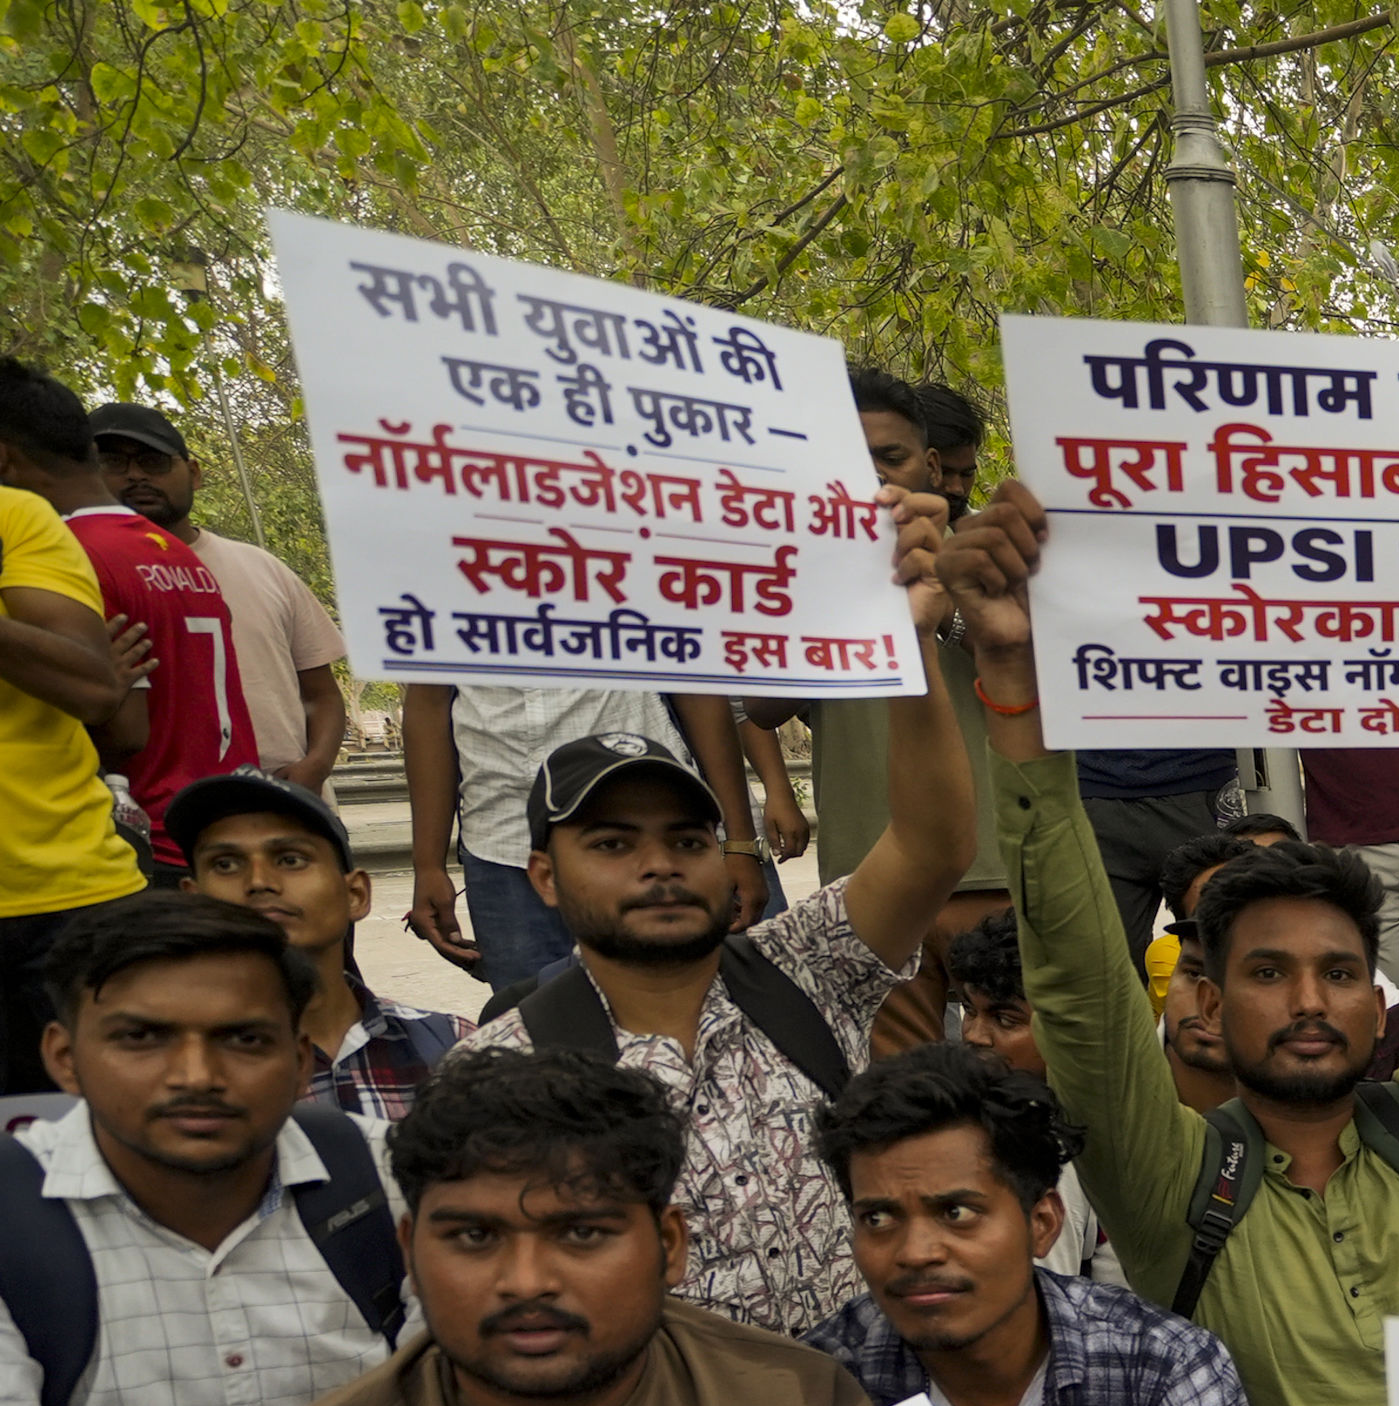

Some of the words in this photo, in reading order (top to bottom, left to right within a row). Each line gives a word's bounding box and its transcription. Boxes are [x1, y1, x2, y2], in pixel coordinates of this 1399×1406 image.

[349, 262, 498, 338] सभी
[516, 293, 706, 377] युवाओं
[719, 327, 784, 391] की
[442, 356, 541, 412] एक
[557, 364, 614, 427] ही
[630, 384, 756, 448] पुकार
[336, 419, 702, 523] नॉर्मलाइजेशन
[719, 469, 795, 533] डेटा
[808, 480, 880, 541] और
[136, 564, 221, 593] RONALD
[452, 528, 631, 603] स्कोर
[655, 546, 798, 617] कार्ड
[1156, 524, 1373, 582] UPSI
[380, 595, 436, 658] हो
[453, 605, 703, 664] सार्वजनिक
[723, 631, 788, 672] इस
[802, 633, 900, 672] बार!
[1073, 643, 1202, 691] शिफ्ट
[1217, 659, 1331, 697] वाइस
[185, 617, 232, 763] 7
[1265, 699, 1344, 735] डेटा
